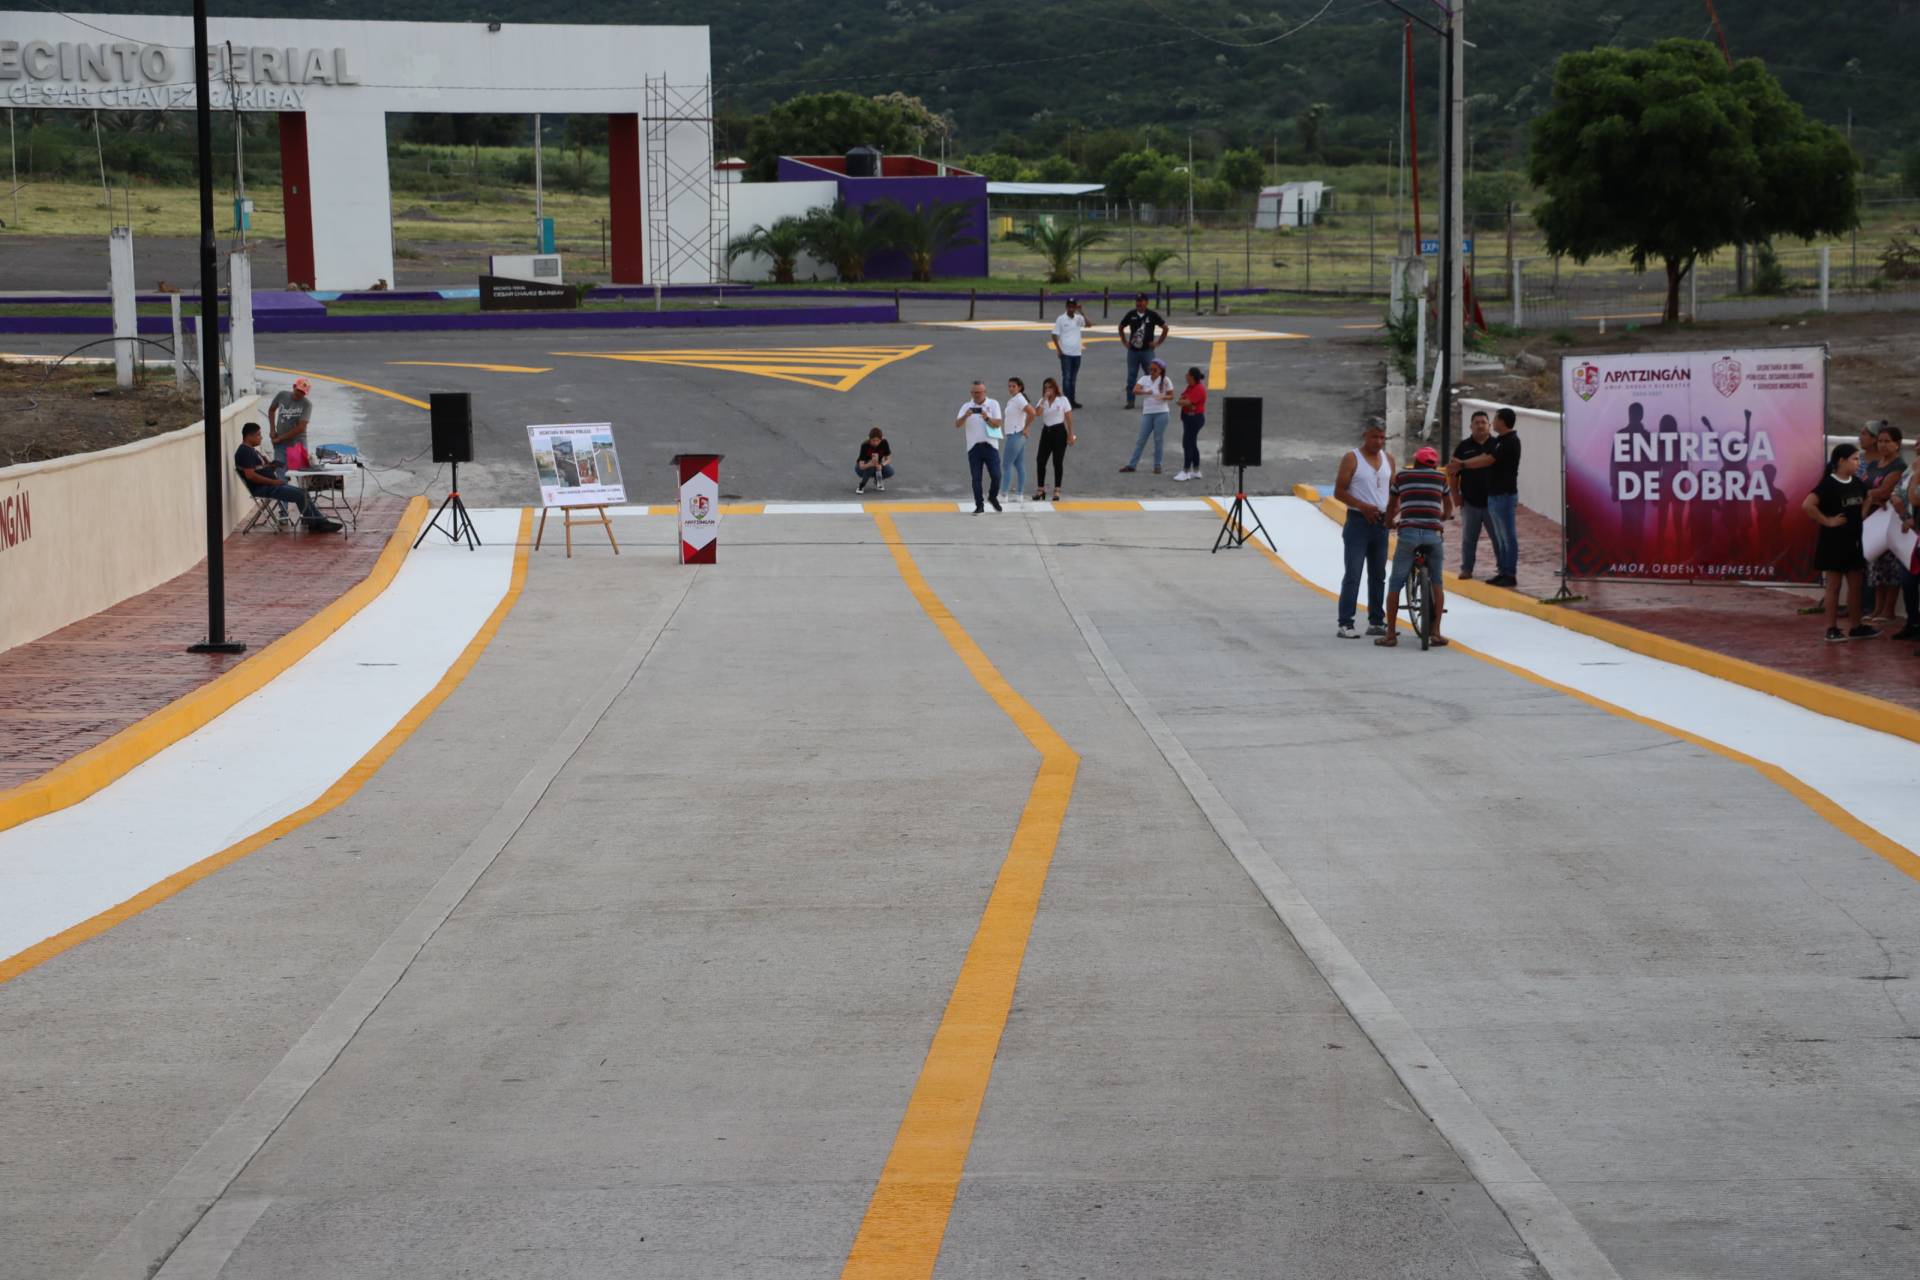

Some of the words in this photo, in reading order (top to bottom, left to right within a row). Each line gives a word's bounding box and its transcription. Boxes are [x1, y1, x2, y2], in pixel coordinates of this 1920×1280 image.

[1604, 365, 1692, 384] APATZINGÁN
[1613, 431, 1775, 462] ENTREGA
[1618, 471, 1660, 500] DE
[1672, 470, 1772, 501] OBRA
[1652, 563, 1695, 574] ORDEN
[1698, 565, 1705, 574] Y
[1707, 565, 1775, 576] BIENESTAR
